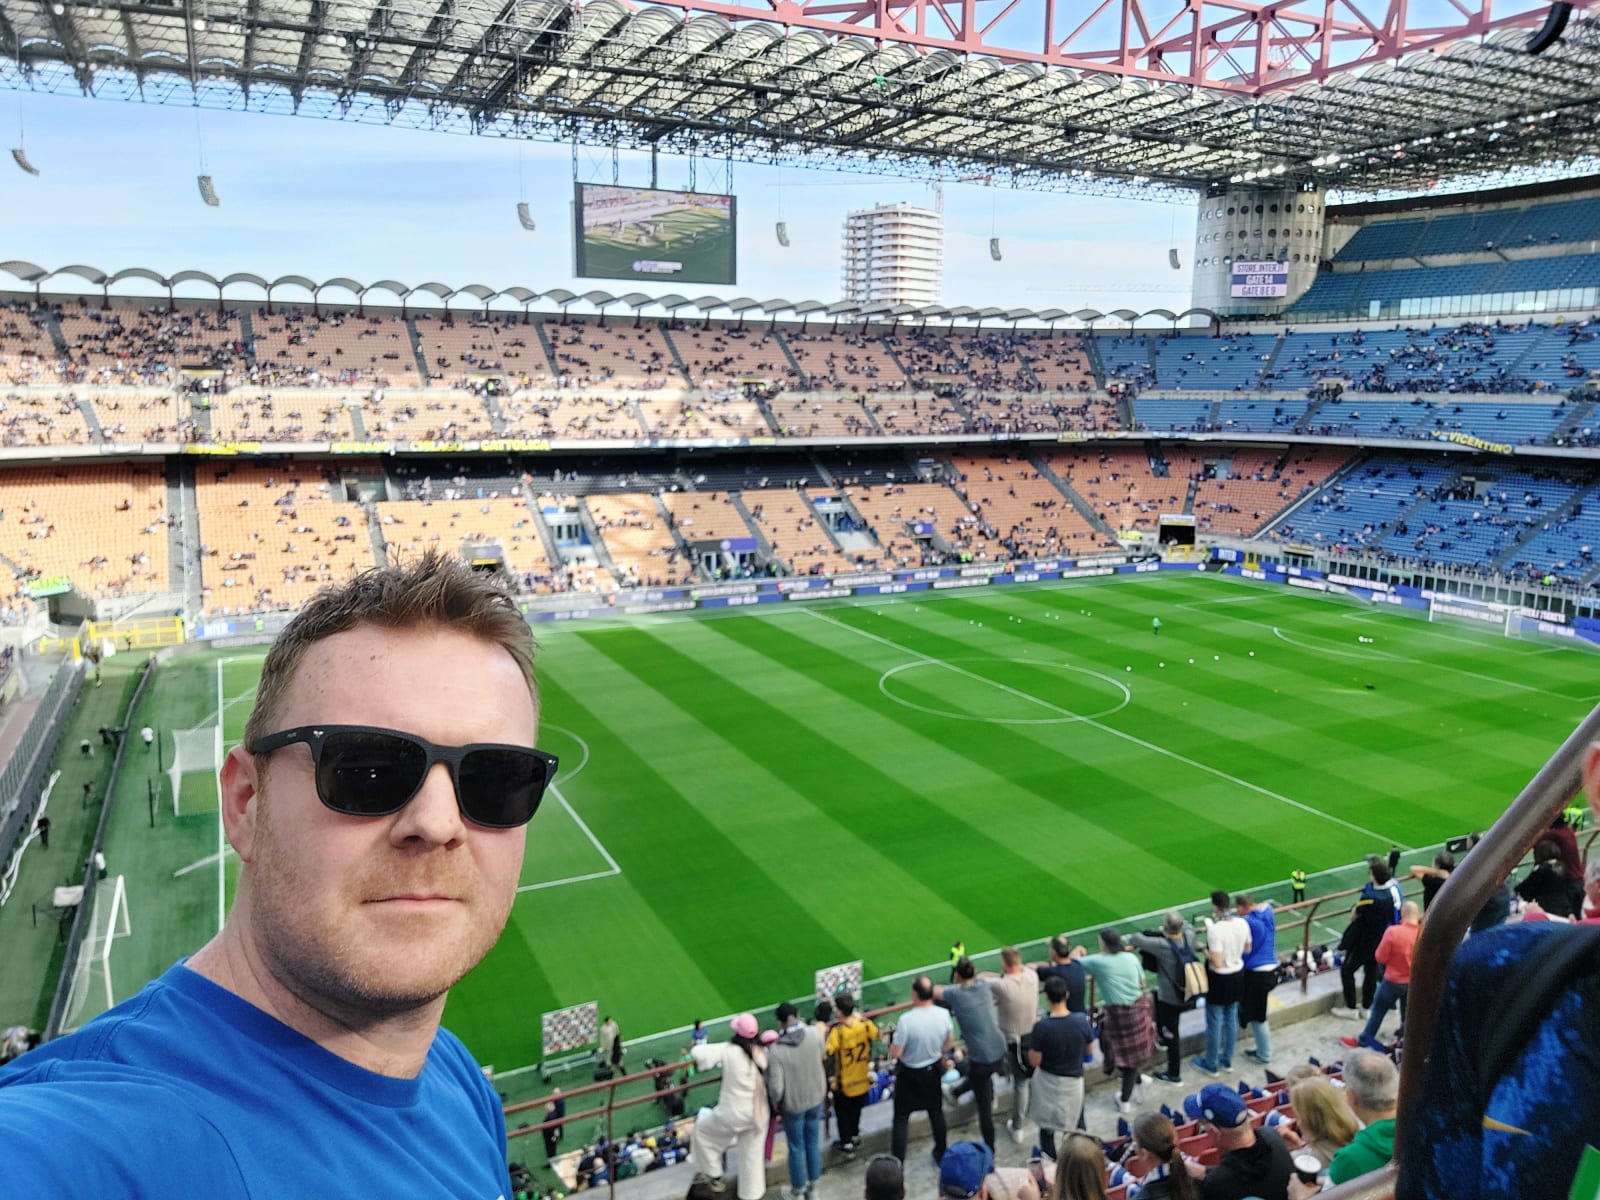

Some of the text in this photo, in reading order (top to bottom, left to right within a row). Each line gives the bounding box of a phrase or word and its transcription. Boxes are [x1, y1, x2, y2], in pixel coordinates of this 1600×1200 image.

[1246, 275, 1264, 285] GATE
[1241, 286, 1259, 296] GATE
[845, 1042, 866, 1065] 32
